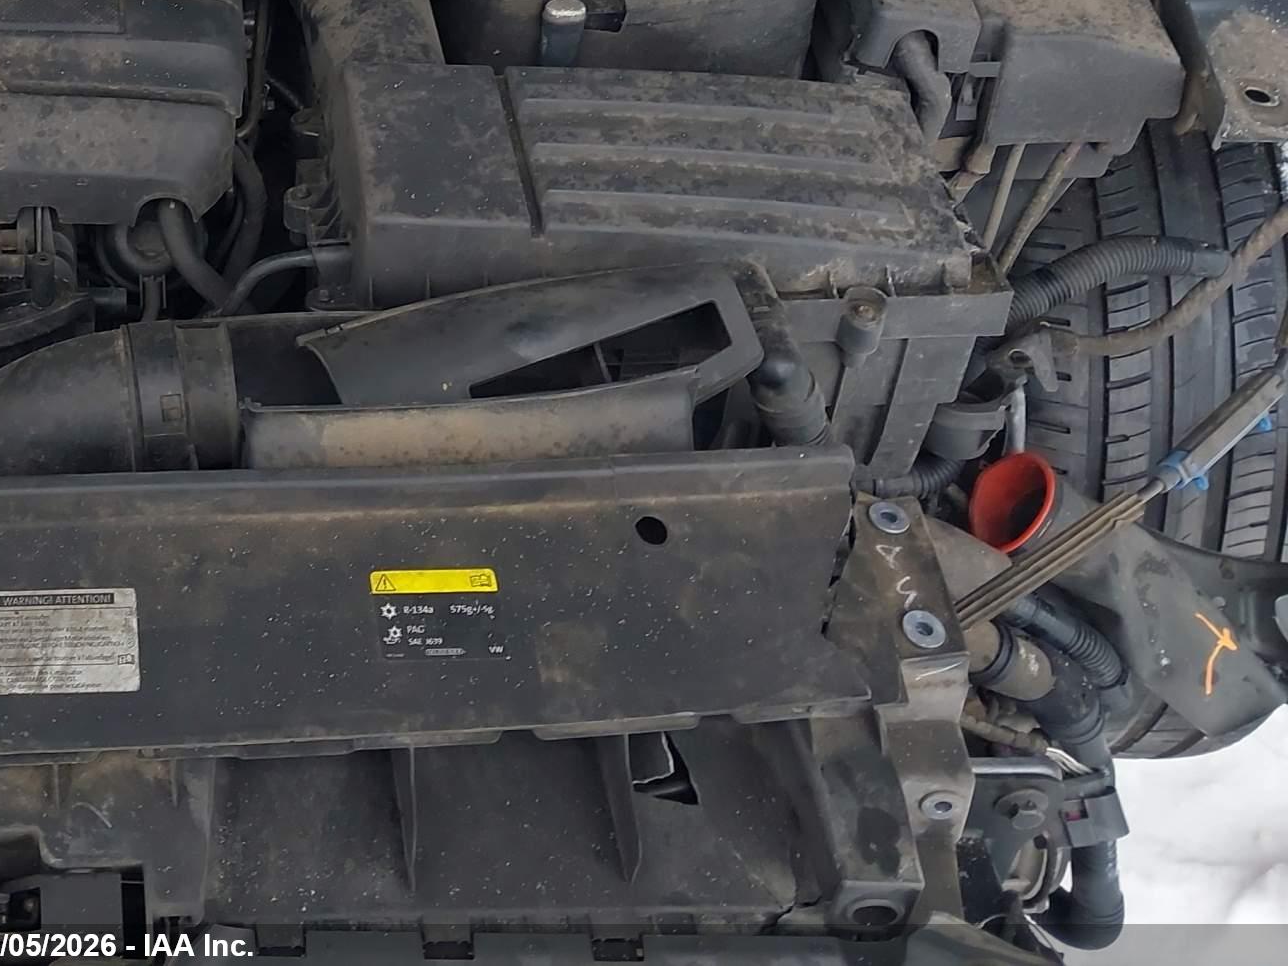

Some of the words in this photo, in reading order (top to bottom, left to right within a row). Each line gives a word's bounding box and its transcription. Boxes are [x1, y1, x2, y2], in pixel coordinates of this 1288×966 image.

[4, 596, 53, 607] WARNING!
[55, 595, 112, 605] ATTENTION!
[406, 625, 425, 634] PAG
